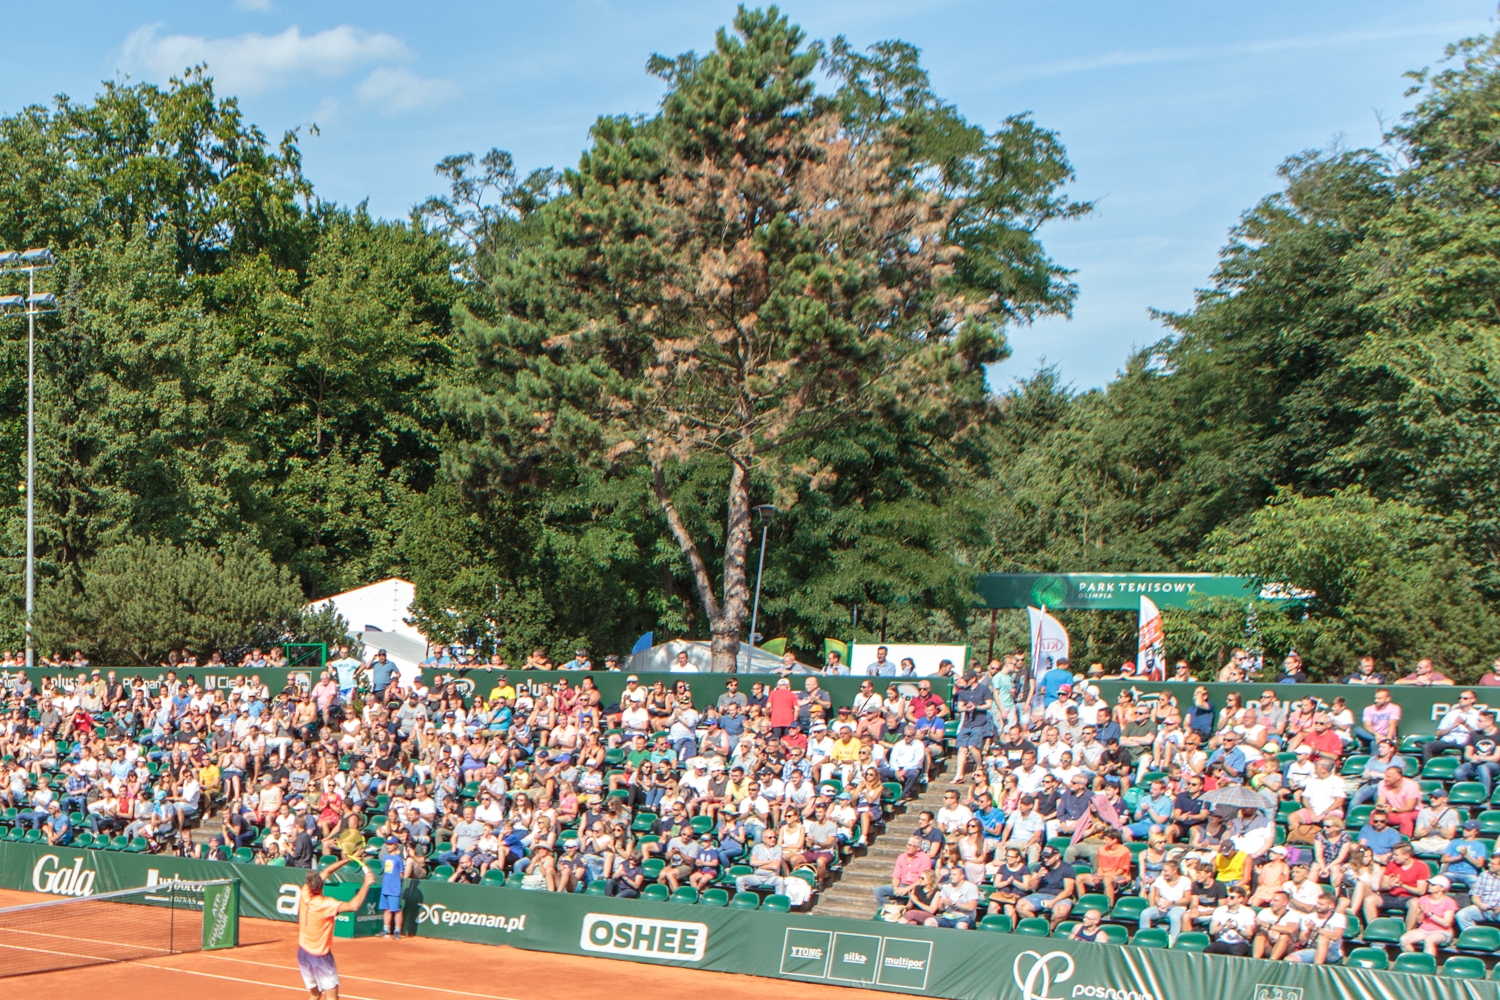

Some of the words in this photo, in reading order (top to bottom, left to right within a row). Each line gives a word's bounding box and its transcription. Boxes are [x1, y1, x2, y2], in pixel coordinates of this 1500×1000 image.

[1078, 582, 1115, 592] PARK
[1118, 582, 1195, 592] TENISOWY
[32, 854, 96, 897] Gala
[441, 909, 526, 932] epoznan.pl
[589, 920, 699, 955] OSHEE
[791, 946, 822, 958] YTONG
[843, 952, 867, 963] silka
[885, 956, 924, 970] multipor
